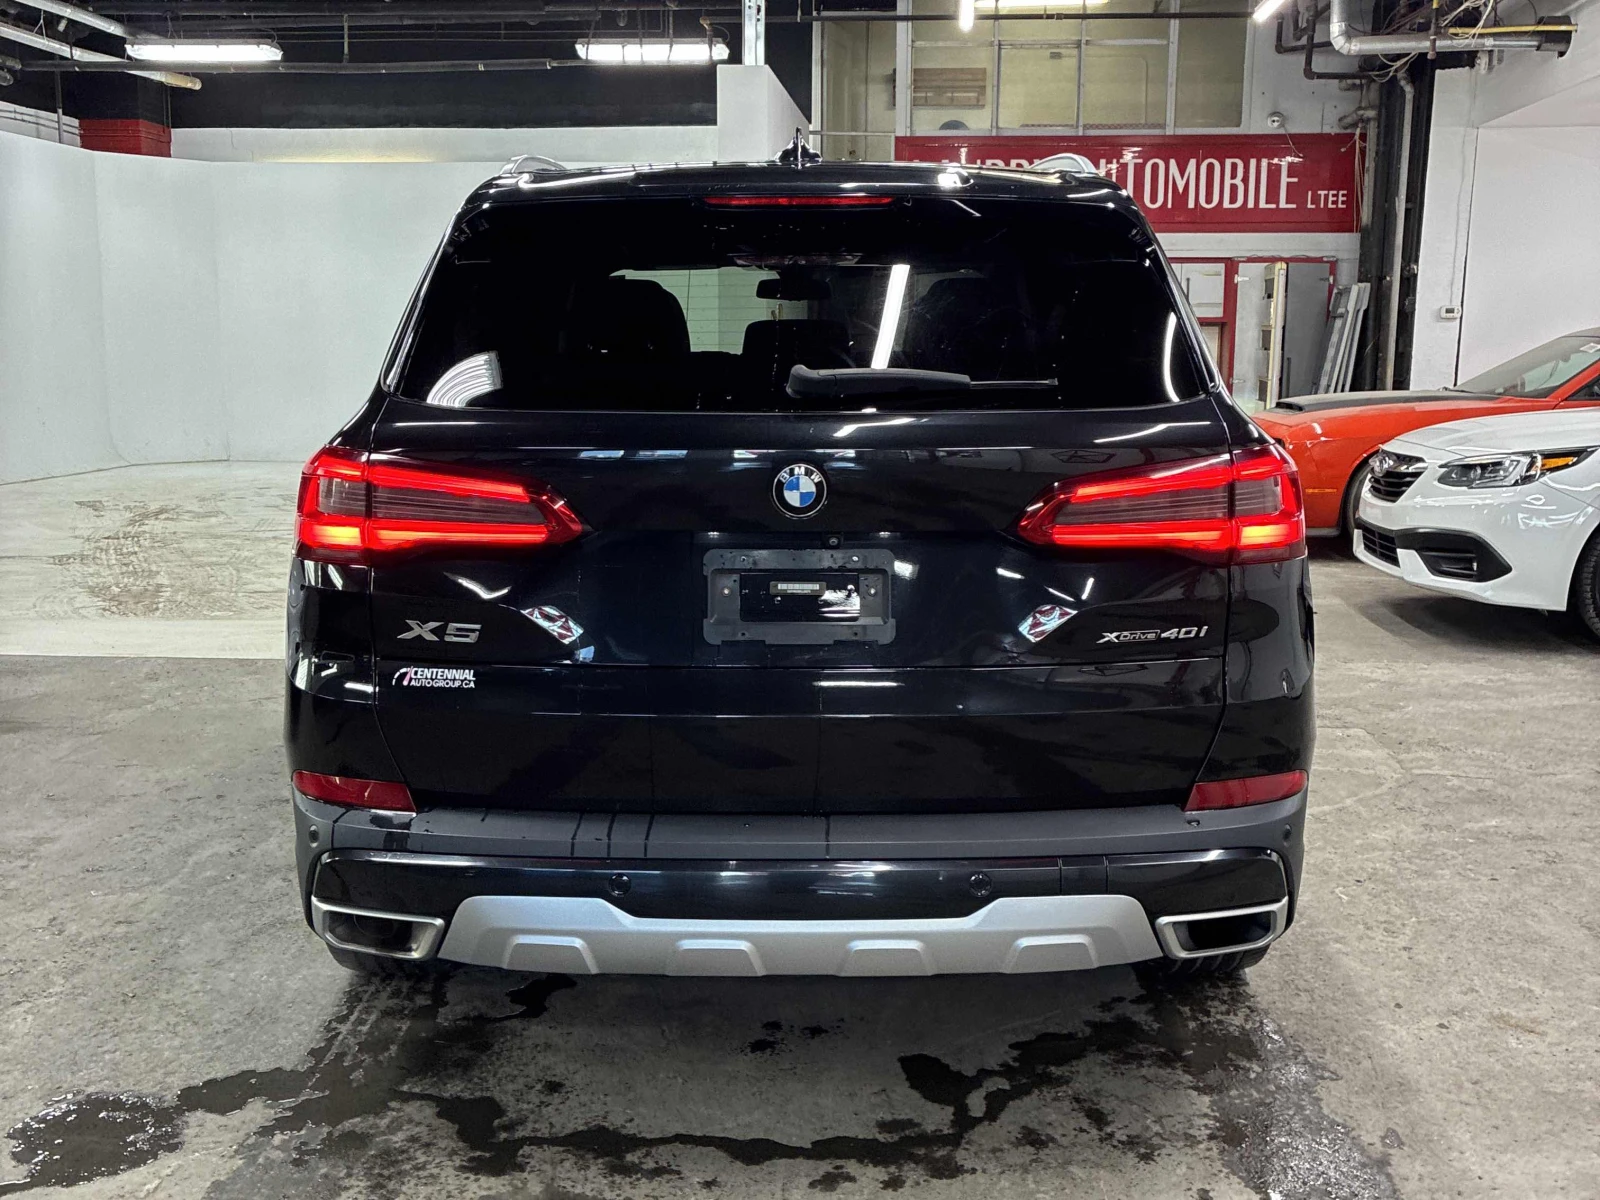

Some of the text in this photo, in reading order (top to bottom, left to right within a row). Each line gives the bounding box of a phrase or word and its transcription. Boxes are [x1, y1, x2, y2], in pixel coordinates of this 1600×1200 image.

[1098, 158, 1348, 209] TOMOBILE LTEE
[778, 466, 822, 483] BMW
[396, 619, 482, 643] X5
[410, 667, 476, 680] CENTENNIAL
